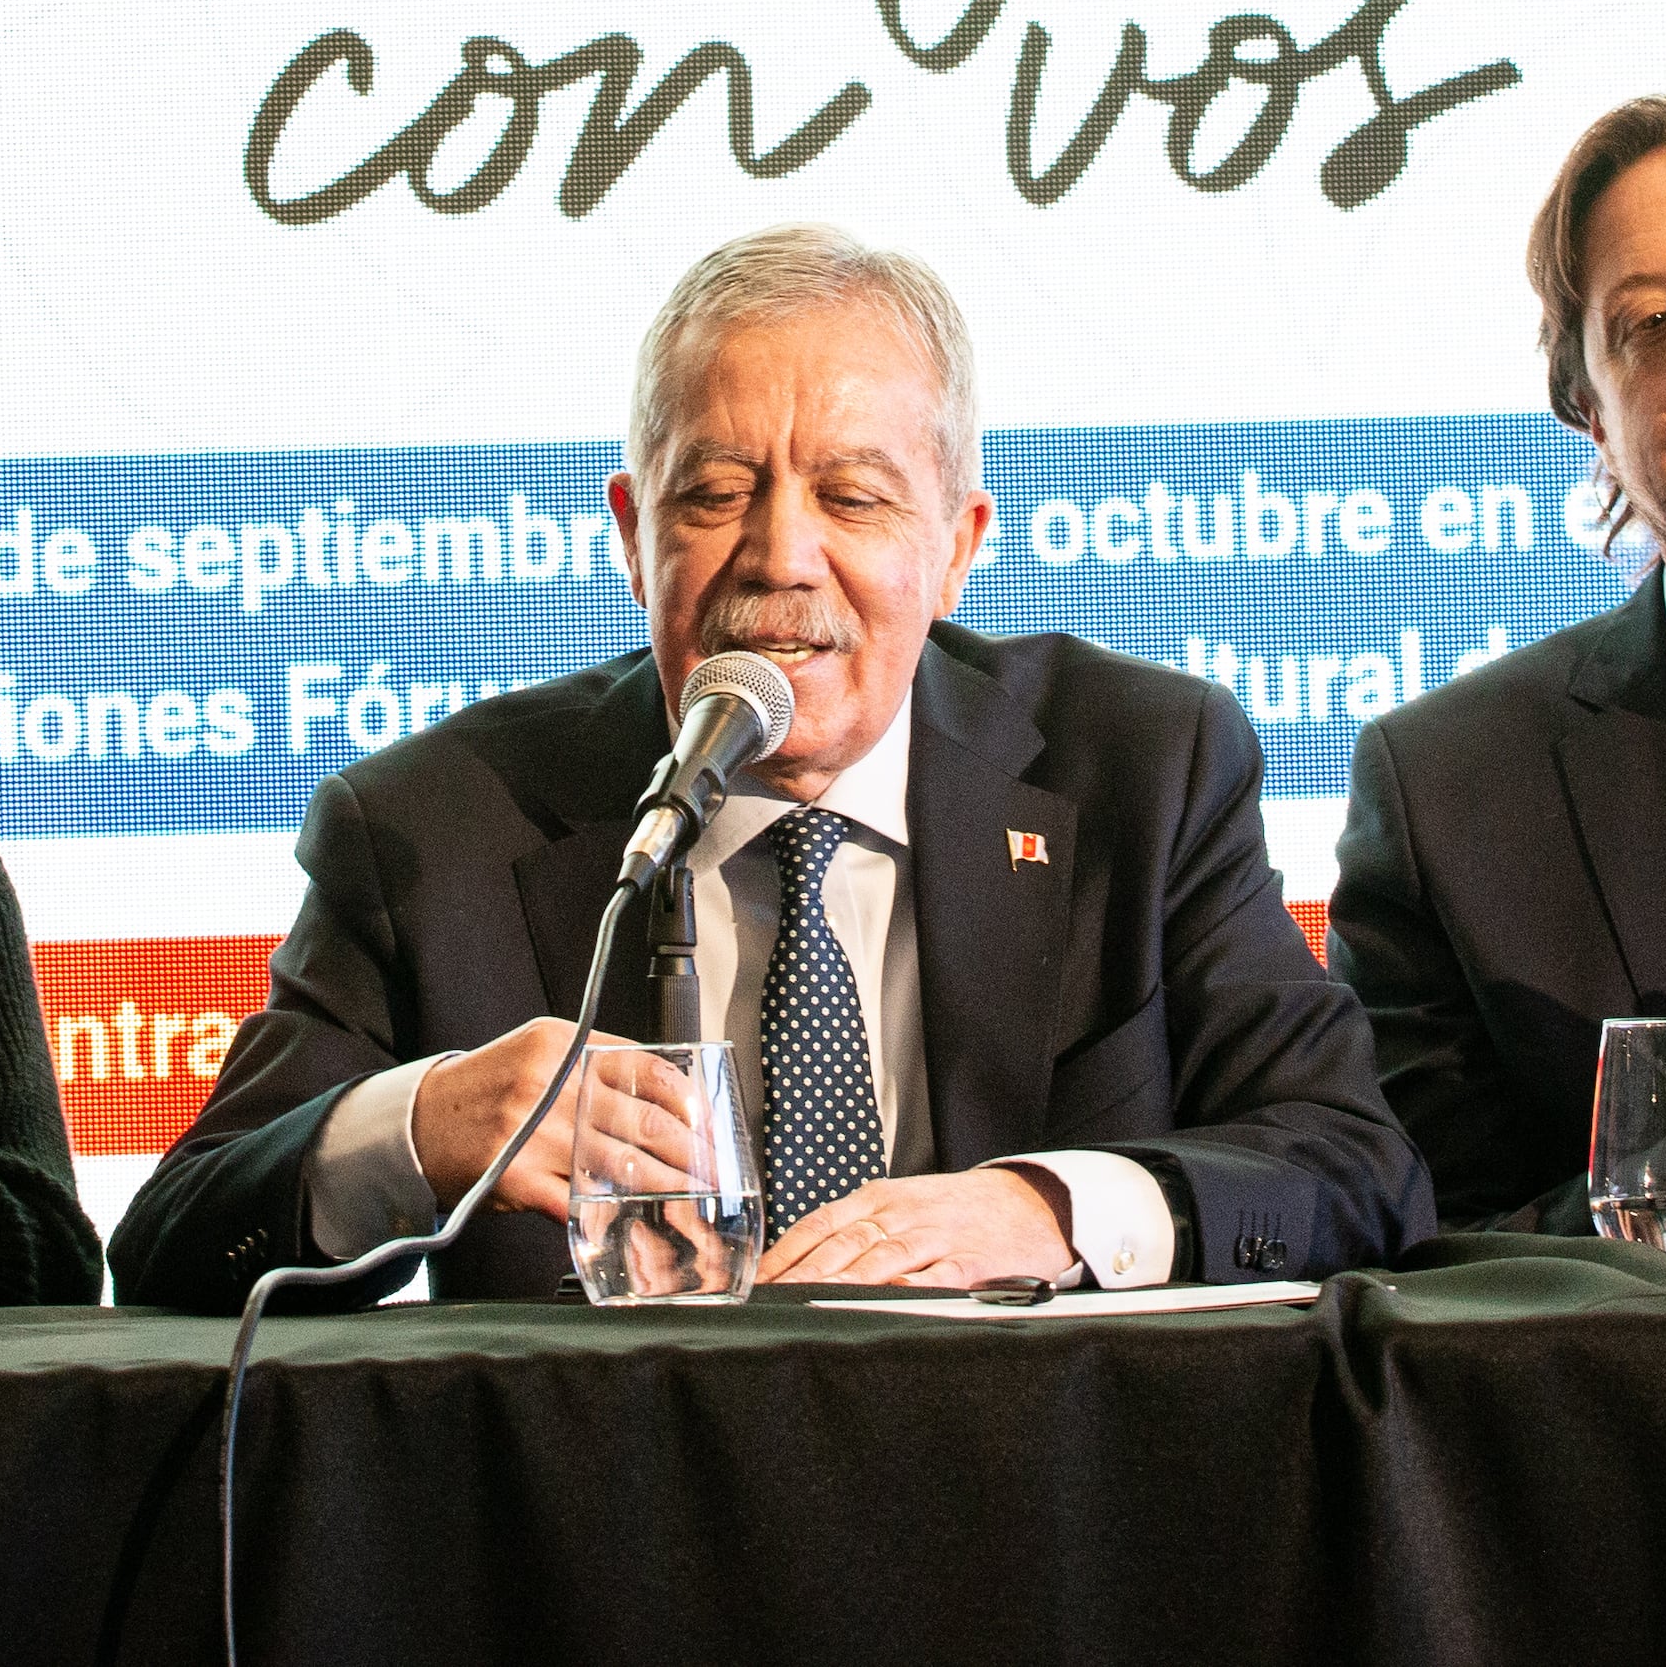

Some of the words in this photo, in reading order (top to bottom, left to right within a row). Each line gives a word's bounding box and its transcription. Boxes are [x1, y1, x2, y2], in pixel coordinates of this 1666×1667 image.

[244, 28, 871, 226] con
[1027, 466, 1395, 568] octubre
[1417, 481, 1536, 556] en
